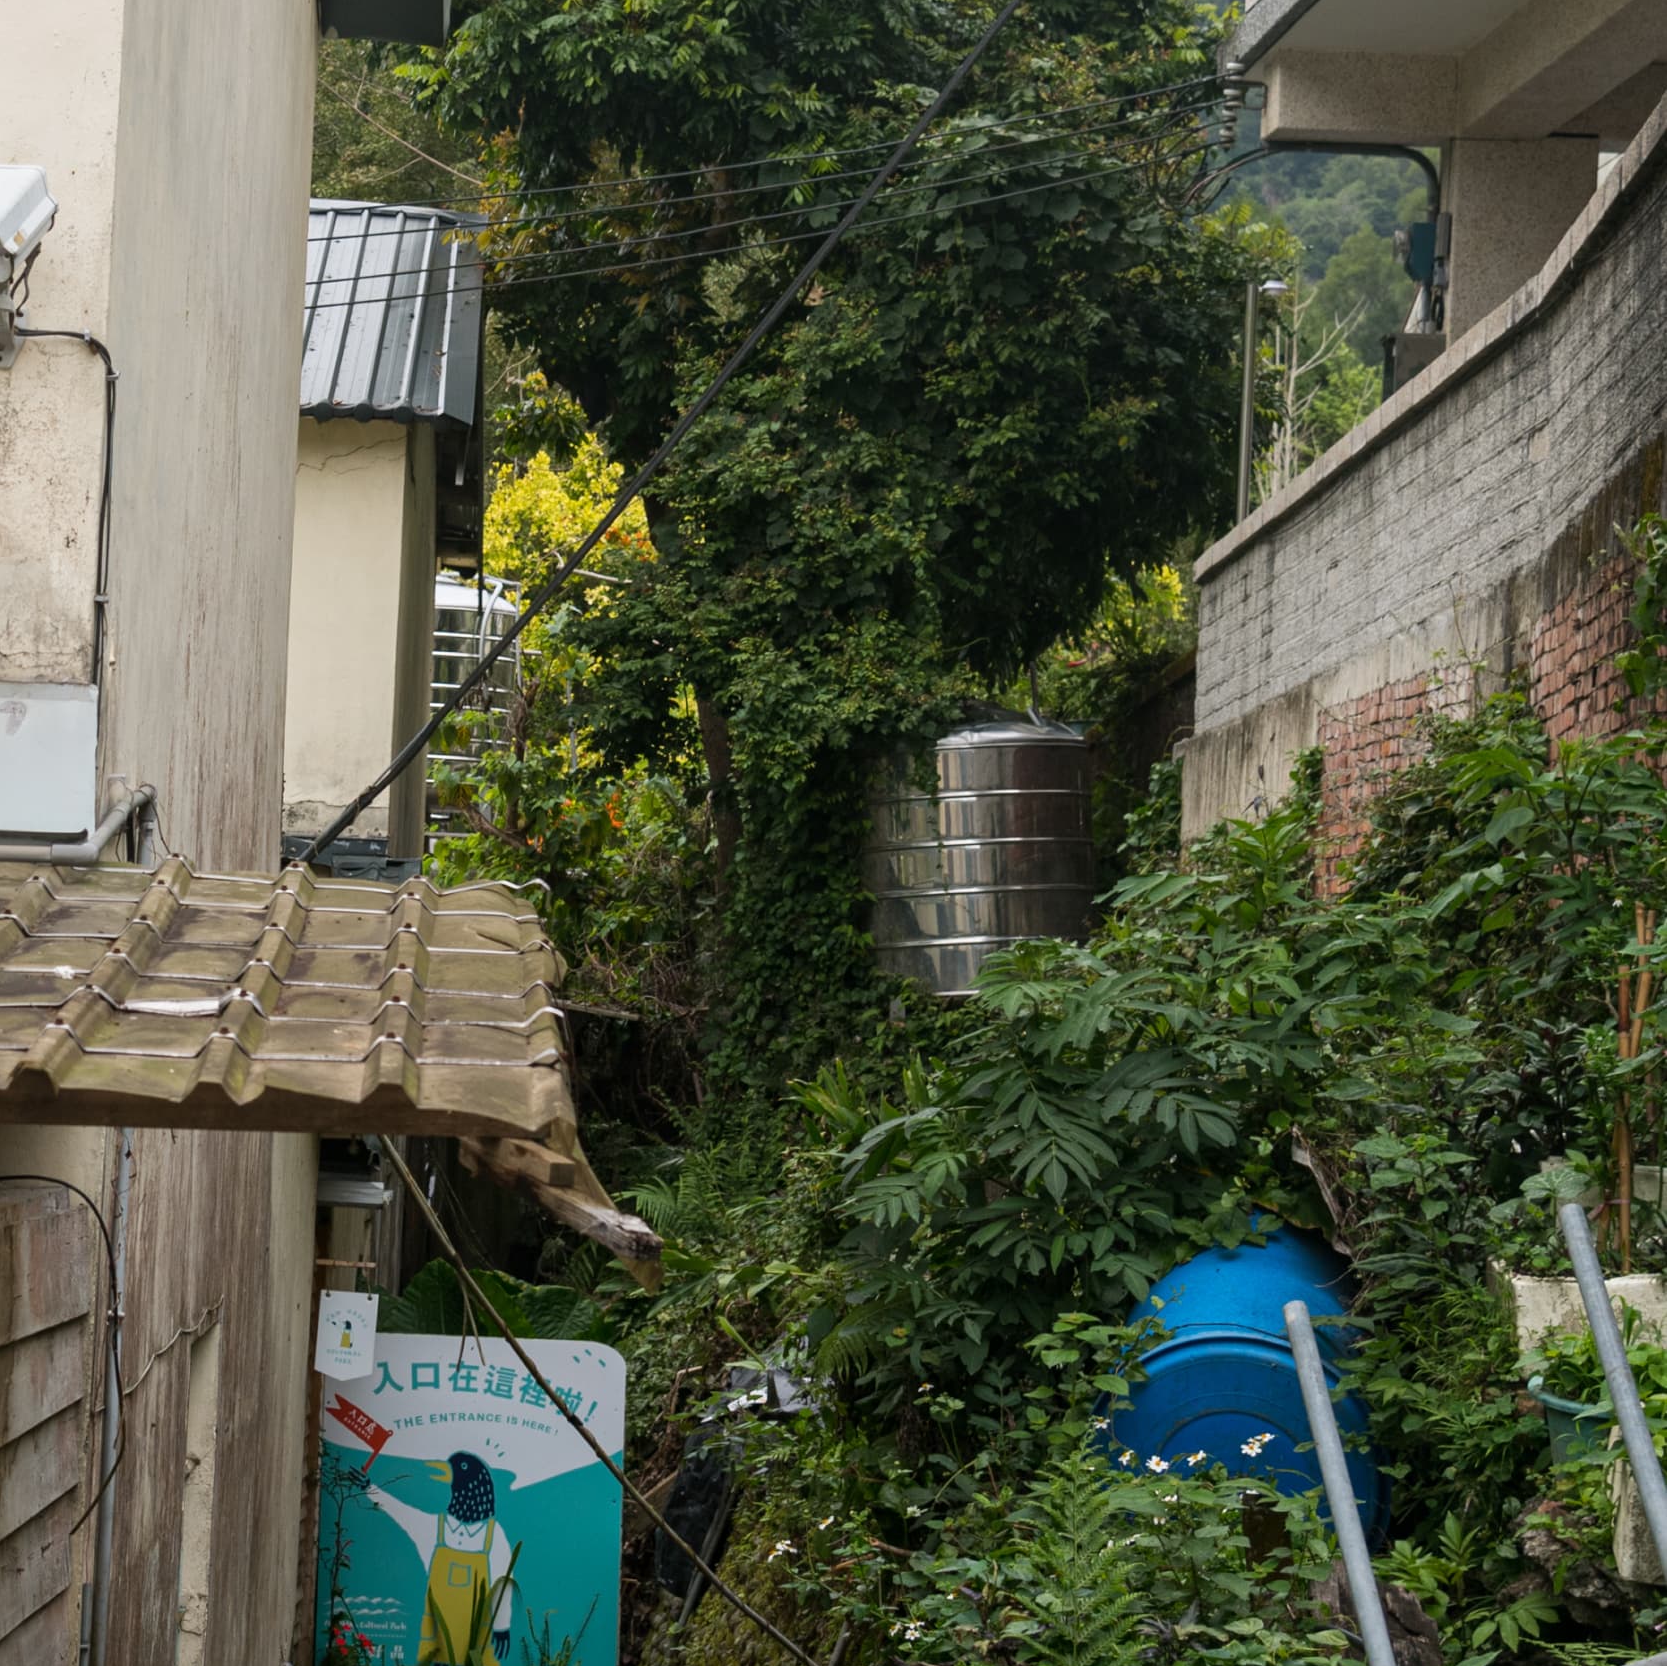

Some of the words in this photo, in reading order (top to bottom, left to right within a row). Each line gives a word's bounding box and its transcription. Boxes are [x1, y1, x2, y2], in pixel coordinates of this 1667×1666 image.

[394, 1415, 424, 1430] THE
[429, 1412, 502, 1424] ENTRANCE
[506, 1416, 518, 1425] IS
